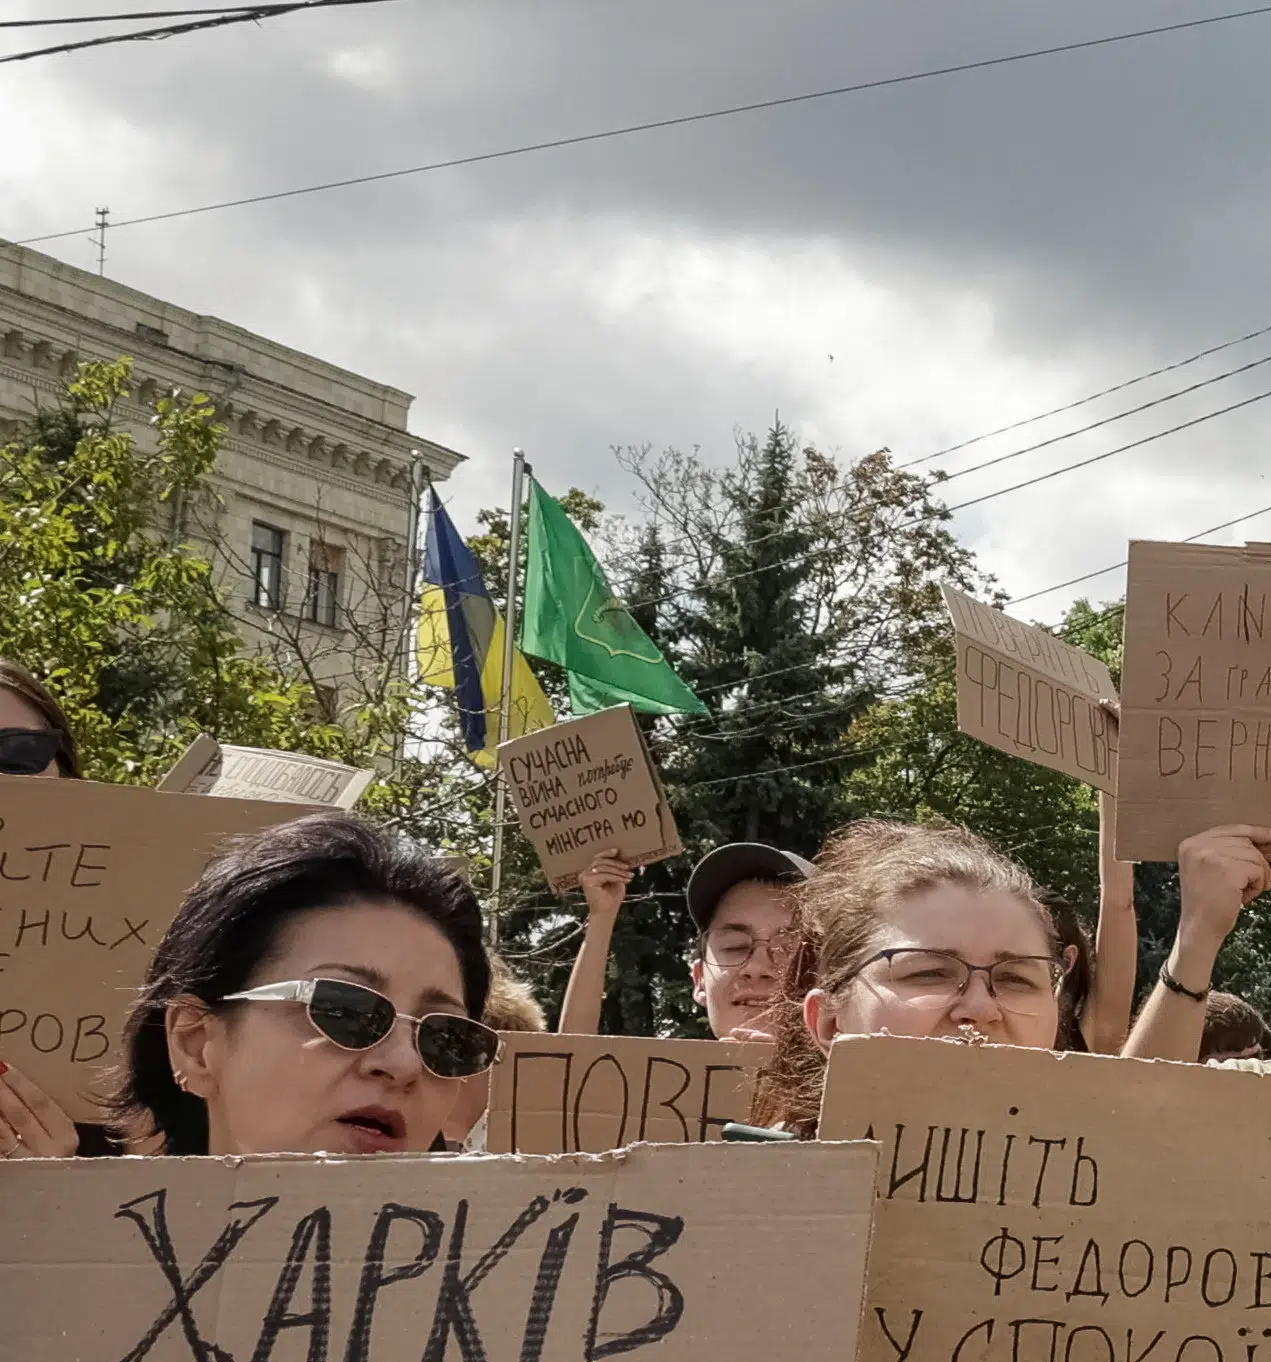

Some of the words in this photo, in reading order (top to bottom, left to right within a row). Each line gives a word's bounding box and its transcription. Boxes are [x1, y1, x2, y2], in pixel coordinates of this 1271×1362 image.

[1155, 650, 1202, 702] ЗА
[509, 734, 591, 785] СУЧАСНА
[518, 776, 567, 809] ВІЙНА
[529, 787, 618, 830] СУЧАСНОГО
[545, 818, 615, 856] МІНІСТРА
[621, 809, 646, 831] МО
[511, 1052, 755, 1154] ПОВЕ
[862, 1106, 1099, 1209] ИШІТЬ
